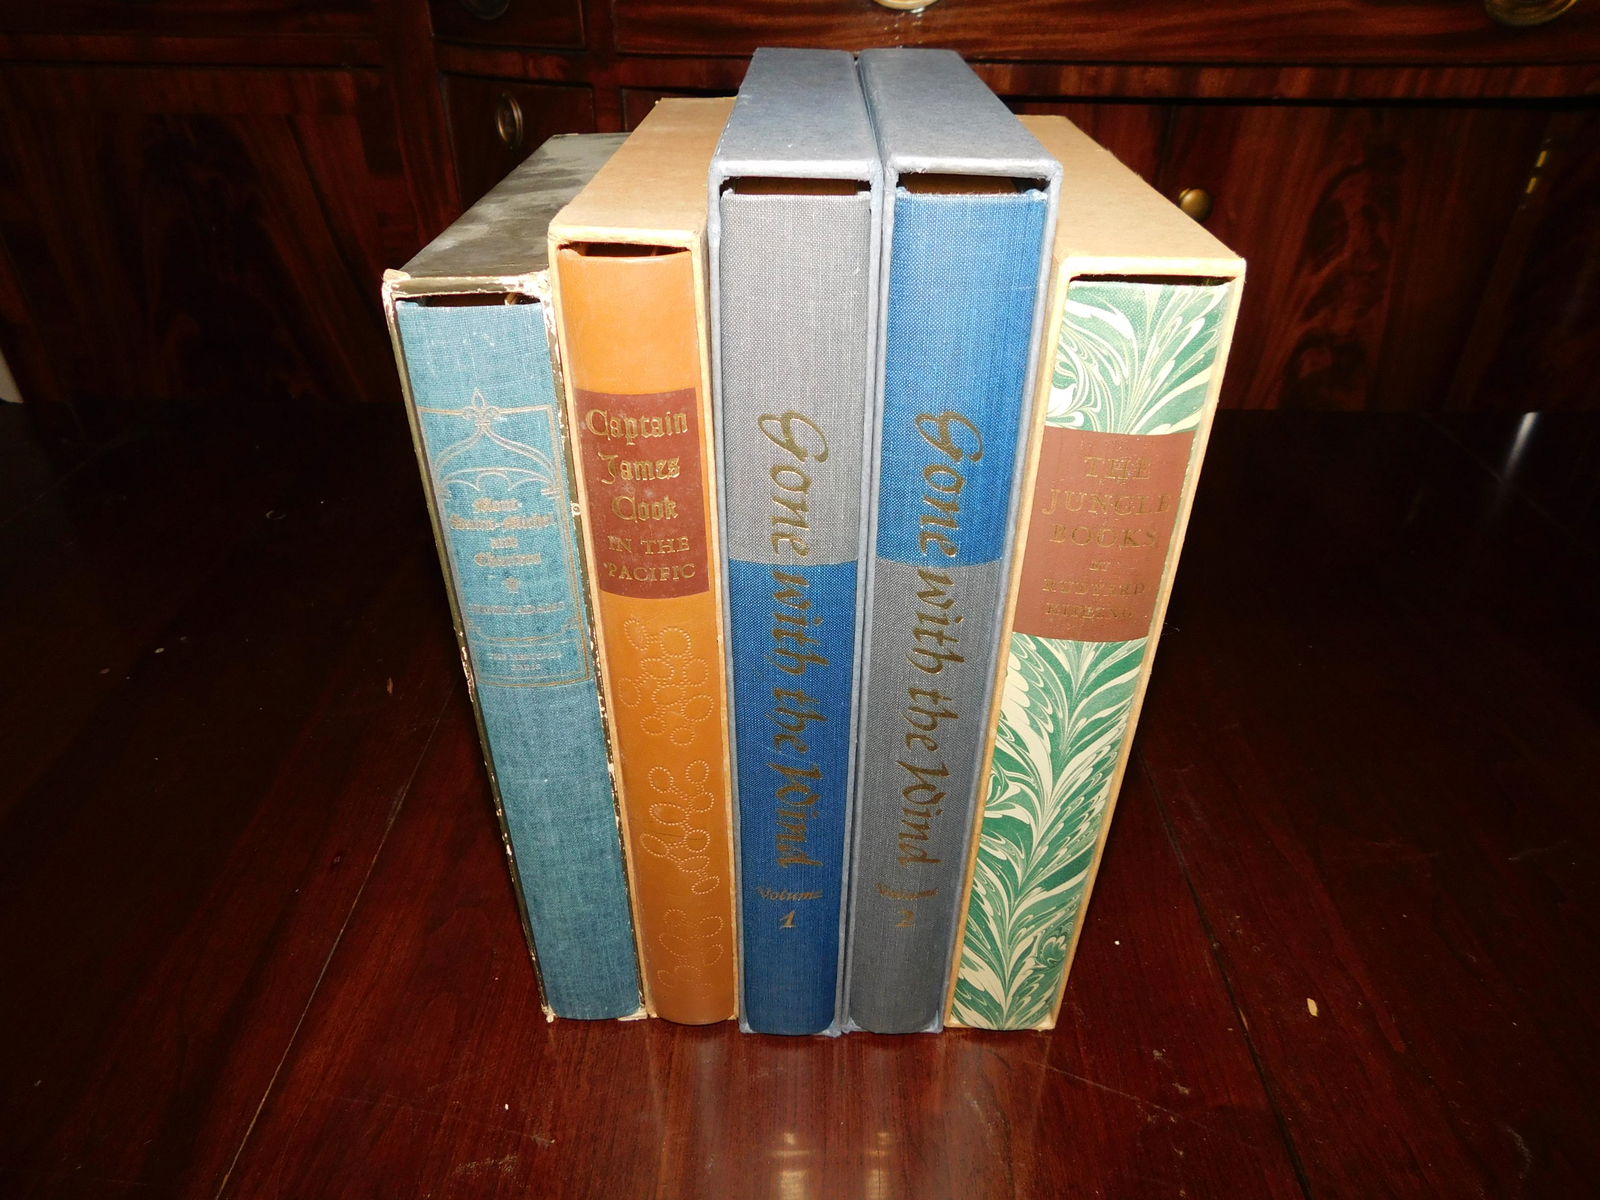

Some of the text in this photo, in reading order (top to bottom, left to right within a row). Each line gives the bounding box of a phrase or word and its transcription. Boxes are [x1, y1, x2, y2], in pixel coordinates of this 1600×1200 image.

[585, 408, 688, 446] Captain
[597, 451, 681, 485] James
[1084, 456, 1151, 480] THE
[611, 494, 679, 523] Cook
[1041, 488, 1173, 516] JUNGLE
[607, 535, 690, 555] IN THE
[1049, 523, 1159, 549] BOOKS
[603, 562, 696, 582] PACIFIC
[757, 410, 830, 869] Gone with the Wind
[896, 410, 984, 867] Gone with the Wind
[757, 884, 823, 901] Volume
[779, 910, 797, 929] 1
